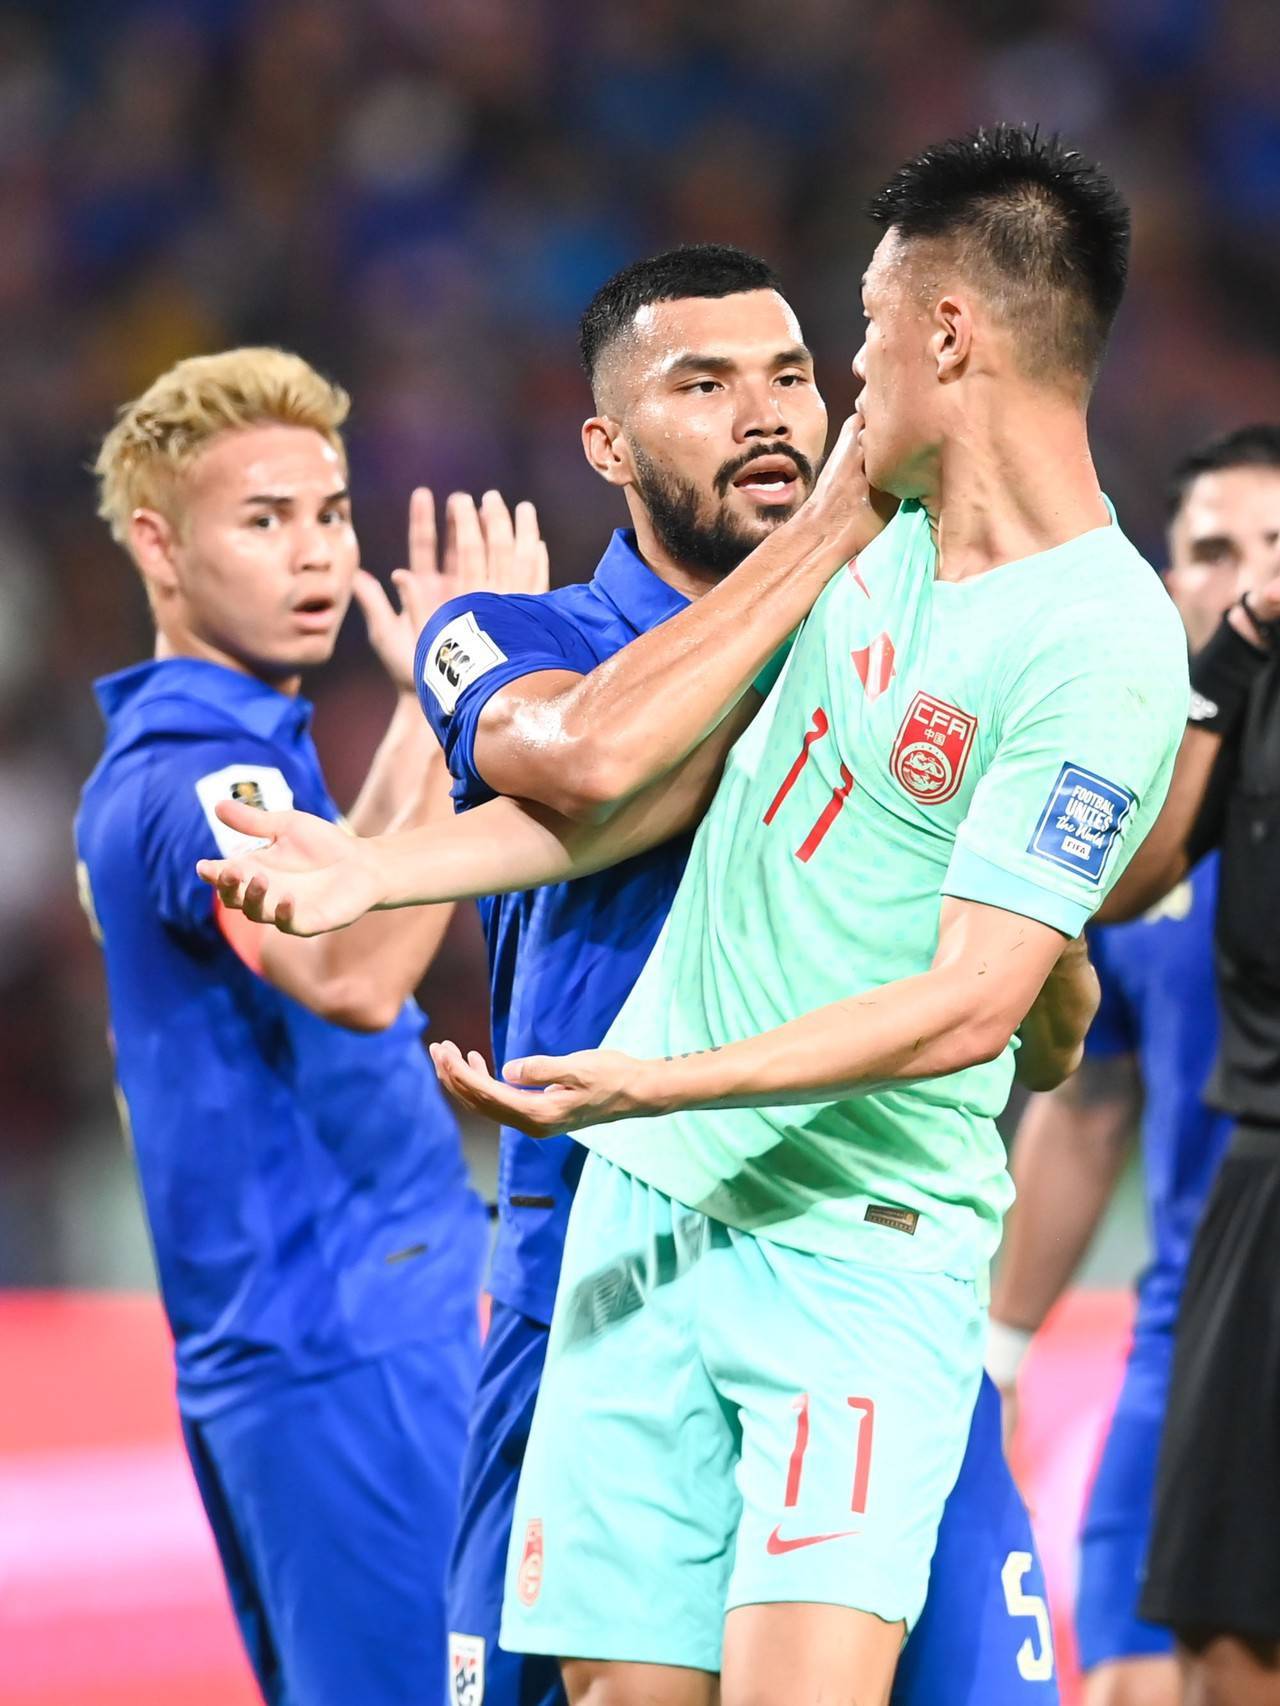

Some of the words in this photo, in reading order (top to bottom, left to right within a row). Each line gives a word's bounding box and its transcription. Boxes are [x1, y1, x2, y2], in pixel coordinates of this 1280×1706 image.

[913, 702, 968, 740] CFA
[924, 728, 946, 746] 中国
[763, 706, 853, 864] 11
[1072, 785, 1115, 814] FOOTBALL
[1056, 815, 1076, 833] the
[1065, 798, 1113, 832] UNITES
[1066, 841, 1086, 855] FIFA
[784, 1393, 875, 1514] 11
[1001, 1551, 1054, 1681] 5
